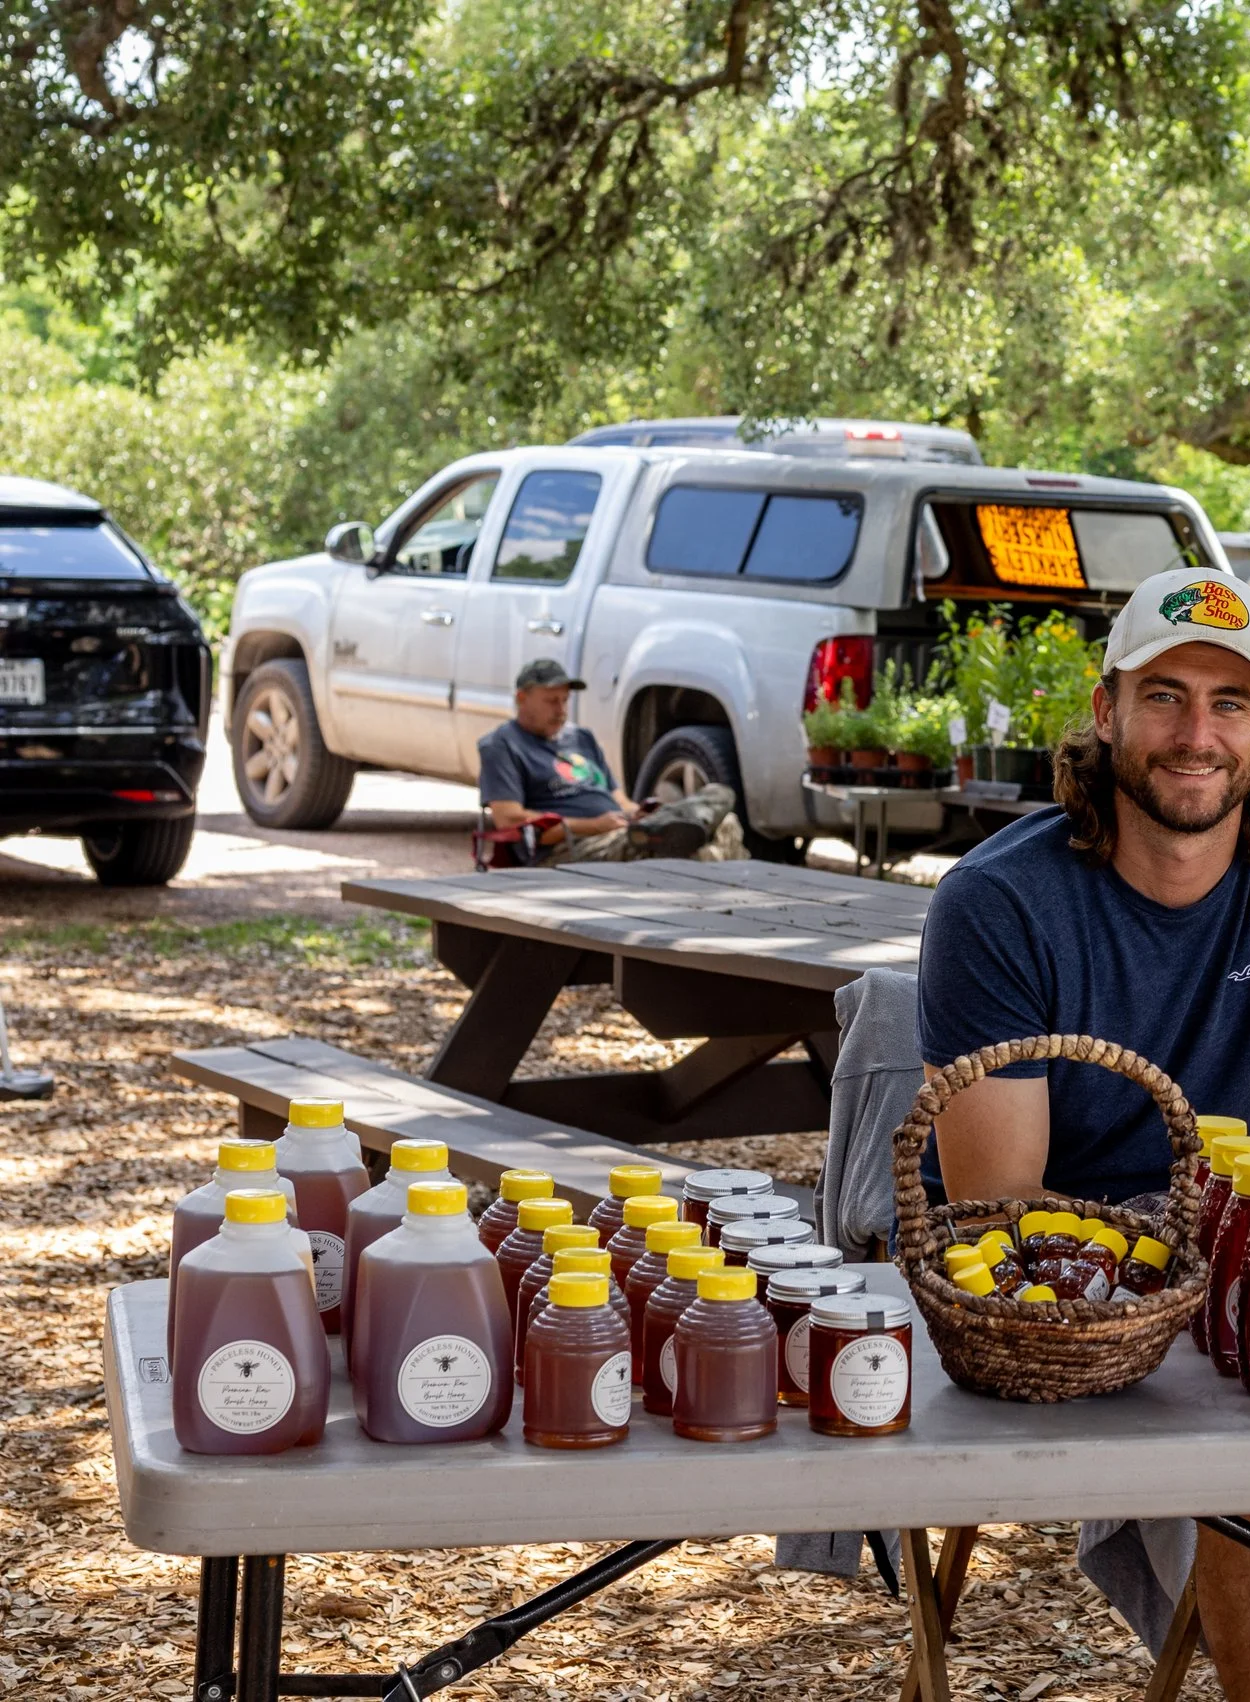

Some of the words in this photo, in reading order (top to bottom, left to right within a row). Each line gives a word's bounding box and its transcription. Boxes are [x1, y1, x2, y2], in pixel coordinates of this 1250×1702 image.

[1202, 582, 1236, 602] Bass
[1205, 593, 1229, 609] Pro
[1203, 604, 1244, 628] Shops
[212, 1348, 254, 1372] PRICELESS
[256, 1350, 283, 1372] HONEY
[411, 1343, 453, 1368] PRICELESS
[454, 1344, 480, 1365] HONEY
[841, 1341, 883, 1366] PRICELESS
[884, 1344, 904, 1362] HONEY
[248, 1396, 268, 1407] Honey
[447, 1390, 467, 1400] Honey
